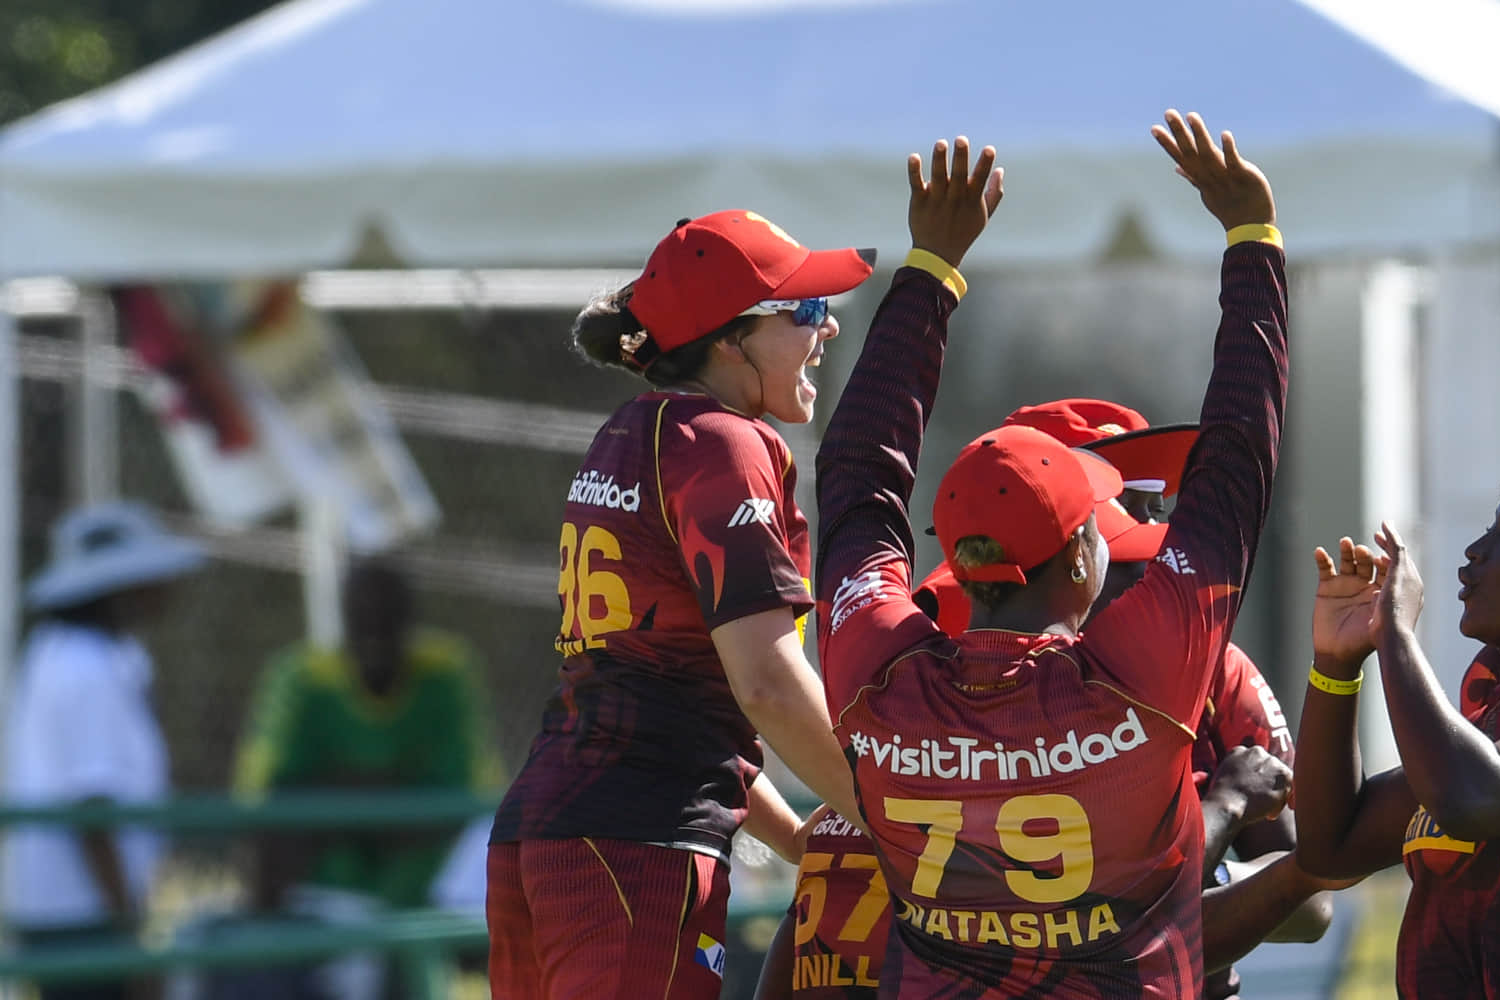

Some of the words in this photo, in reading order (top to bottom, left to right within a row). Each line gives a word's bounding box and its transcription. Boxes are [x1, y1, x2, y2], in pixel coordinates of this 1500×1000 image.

[849, 706, 1151, 782] #visitTrinidad
[882, 793, 1095, 903] 79
[896, 902, 1122, 950] NATASHA
